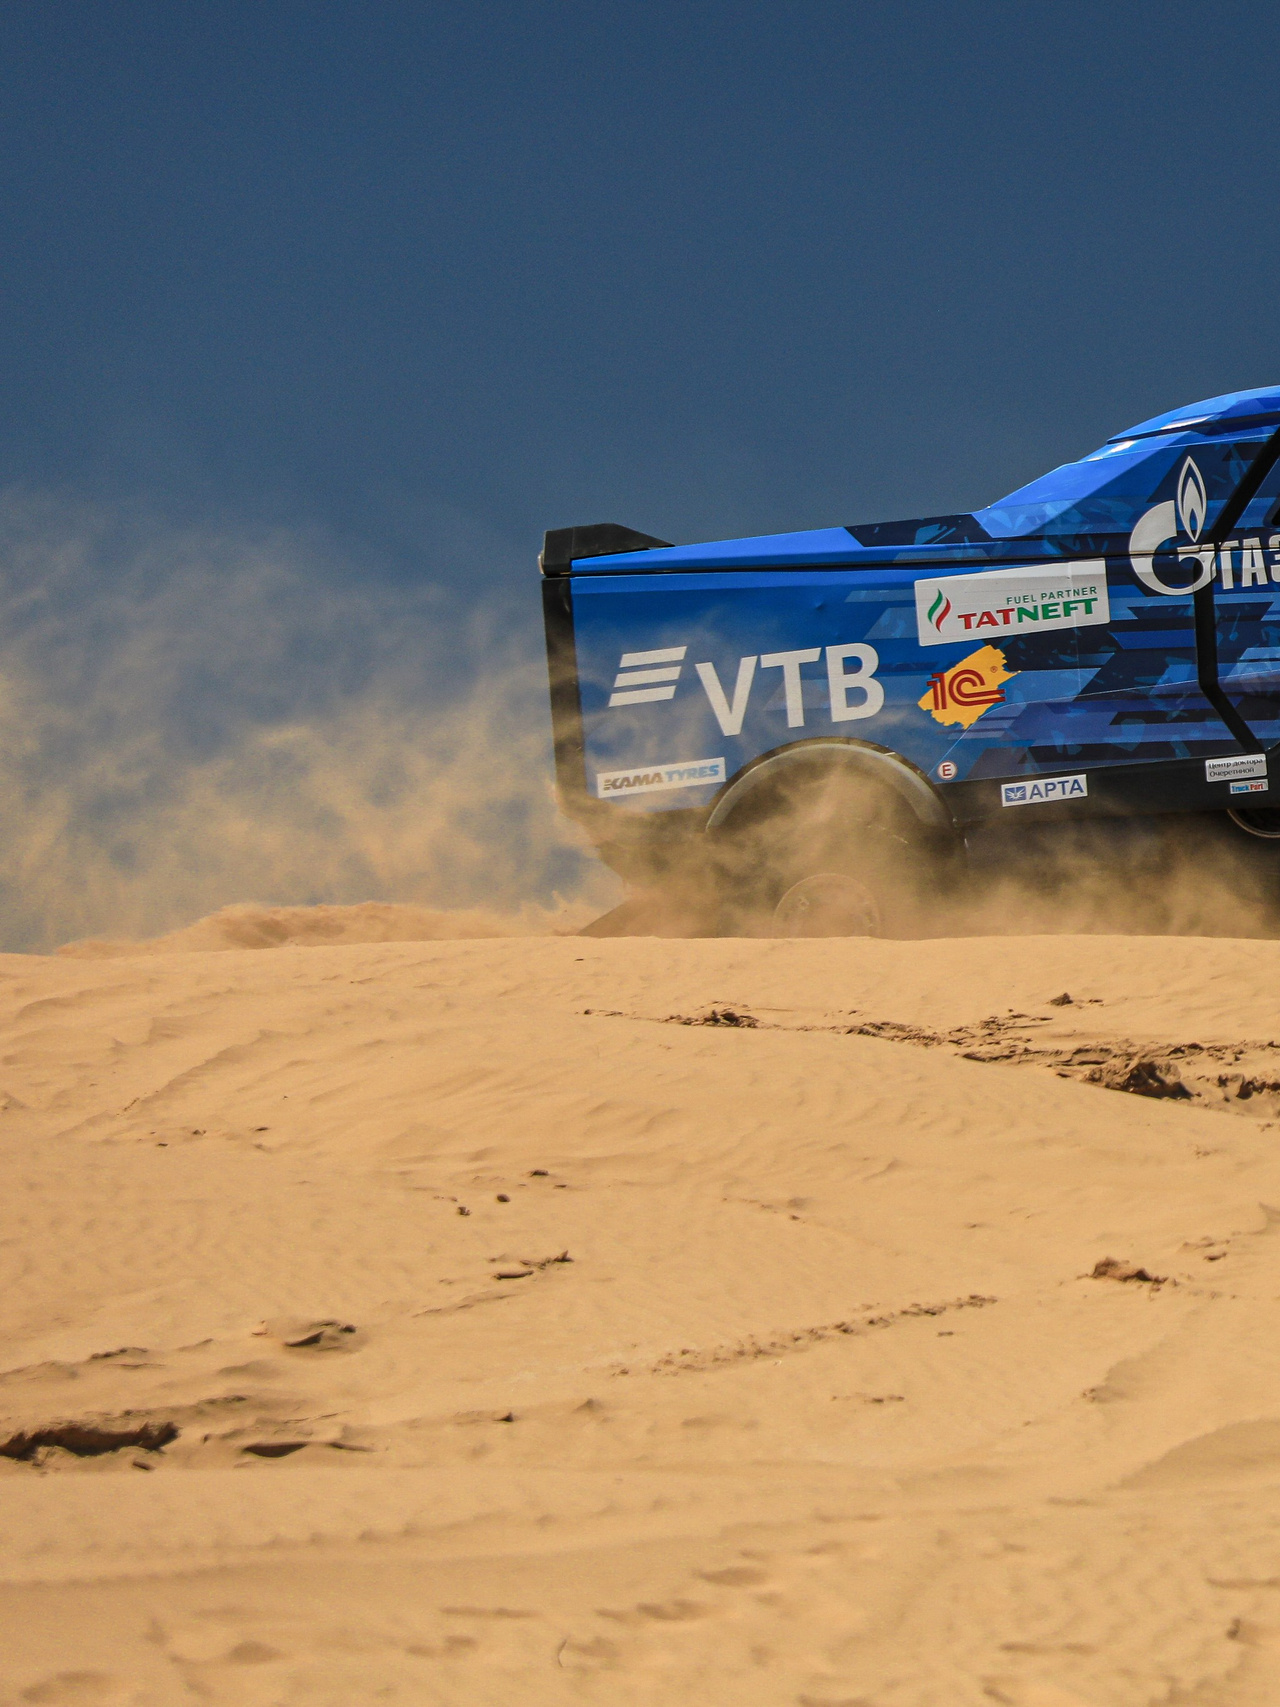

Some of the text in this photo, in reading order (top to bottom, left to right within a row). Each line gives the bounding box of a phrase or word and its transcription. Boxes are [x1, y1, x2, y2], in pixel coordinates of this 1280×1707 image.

[1006, 586, 1098, 606] FUEL PARTNER
[957, 595, 1099, 631] TATNEFT
[695, 642, 885, 737] VTB
[602, 763, 721, 791] KAMA TYRES
